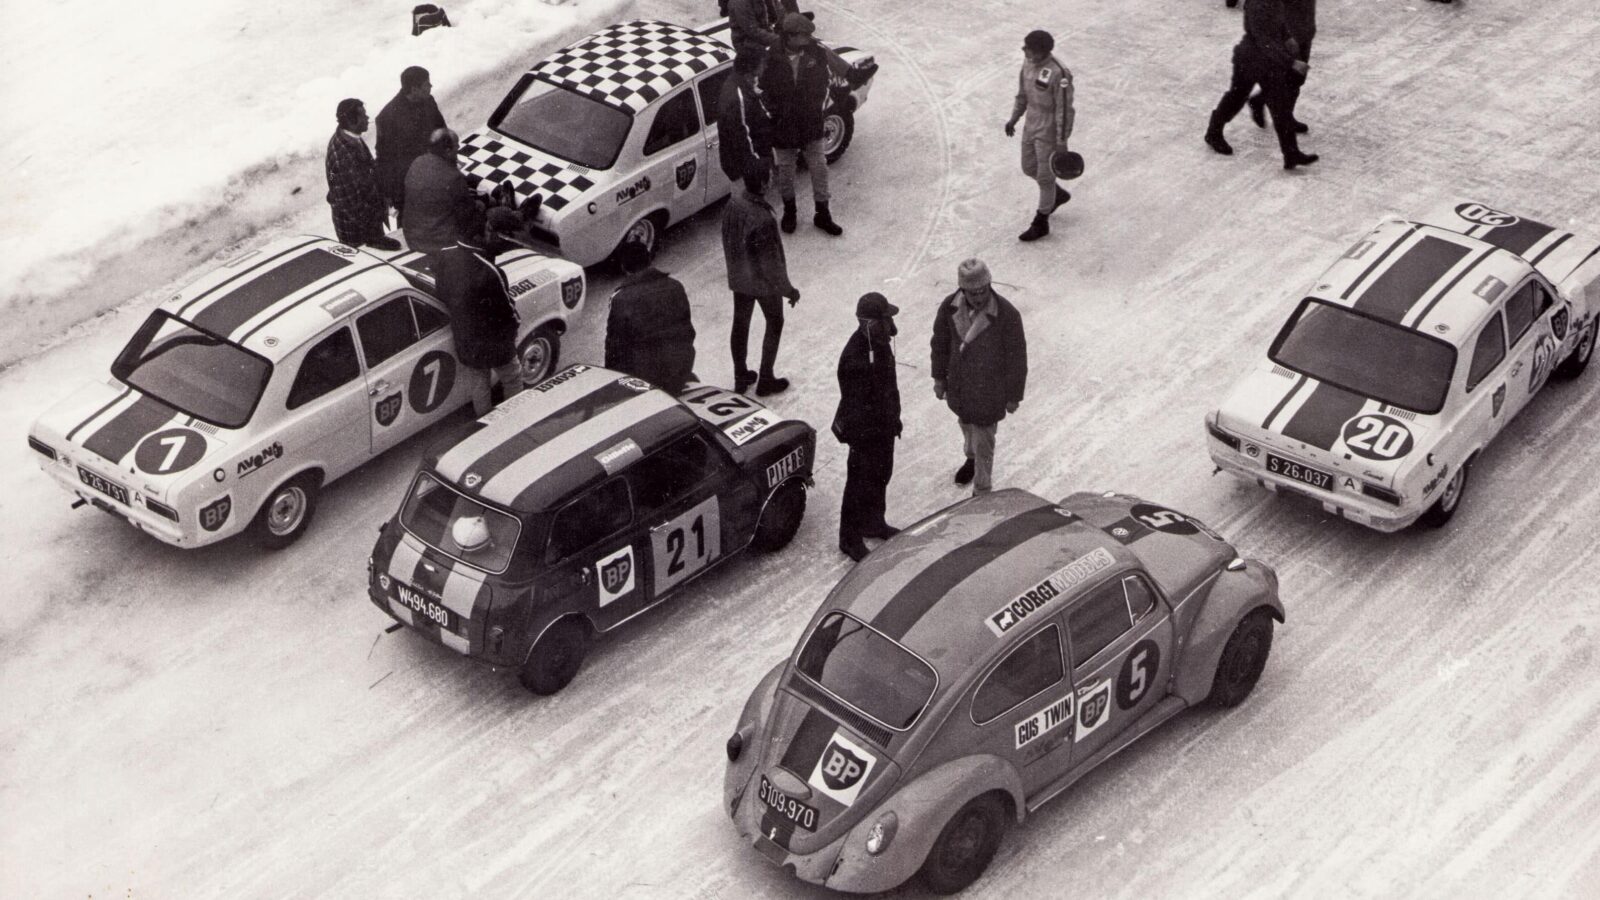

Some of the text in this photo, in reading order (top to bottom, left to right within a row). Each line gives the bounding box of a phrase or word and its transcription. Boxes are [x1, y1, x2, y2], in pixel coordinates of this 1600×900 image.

[1460, 203, 1514, 226] 20
[508, 279, 537, 298] ORGI
[565, 280, 581, 304] BP
[424, 358, 440, 408] 7
[380, 397, 400, 420] BP
[686, 390, 752, 417] 21
[1346, 416, 1409, 458] 20
[158, 435, 187, 472] 7
[1271, 458, 1329, 489] S 26.037
[1343, 477, 1355, 490] A
[204, 501, 229, 528] BP
[1139, 510, 1185, 528] 5
[666, 514, 705, 577] 21
[606, 560, 630, 589] BP
[397, 585, 448, 627] W494.680
[1010, 579, 1060, 618] CORGI
[1129, 649, 1148, 701] 5
[1018, 696, 1072, 745] GUS TWIN
[1083, 694, 1106, 724] BP
[823, 749, 861, 784] BP
